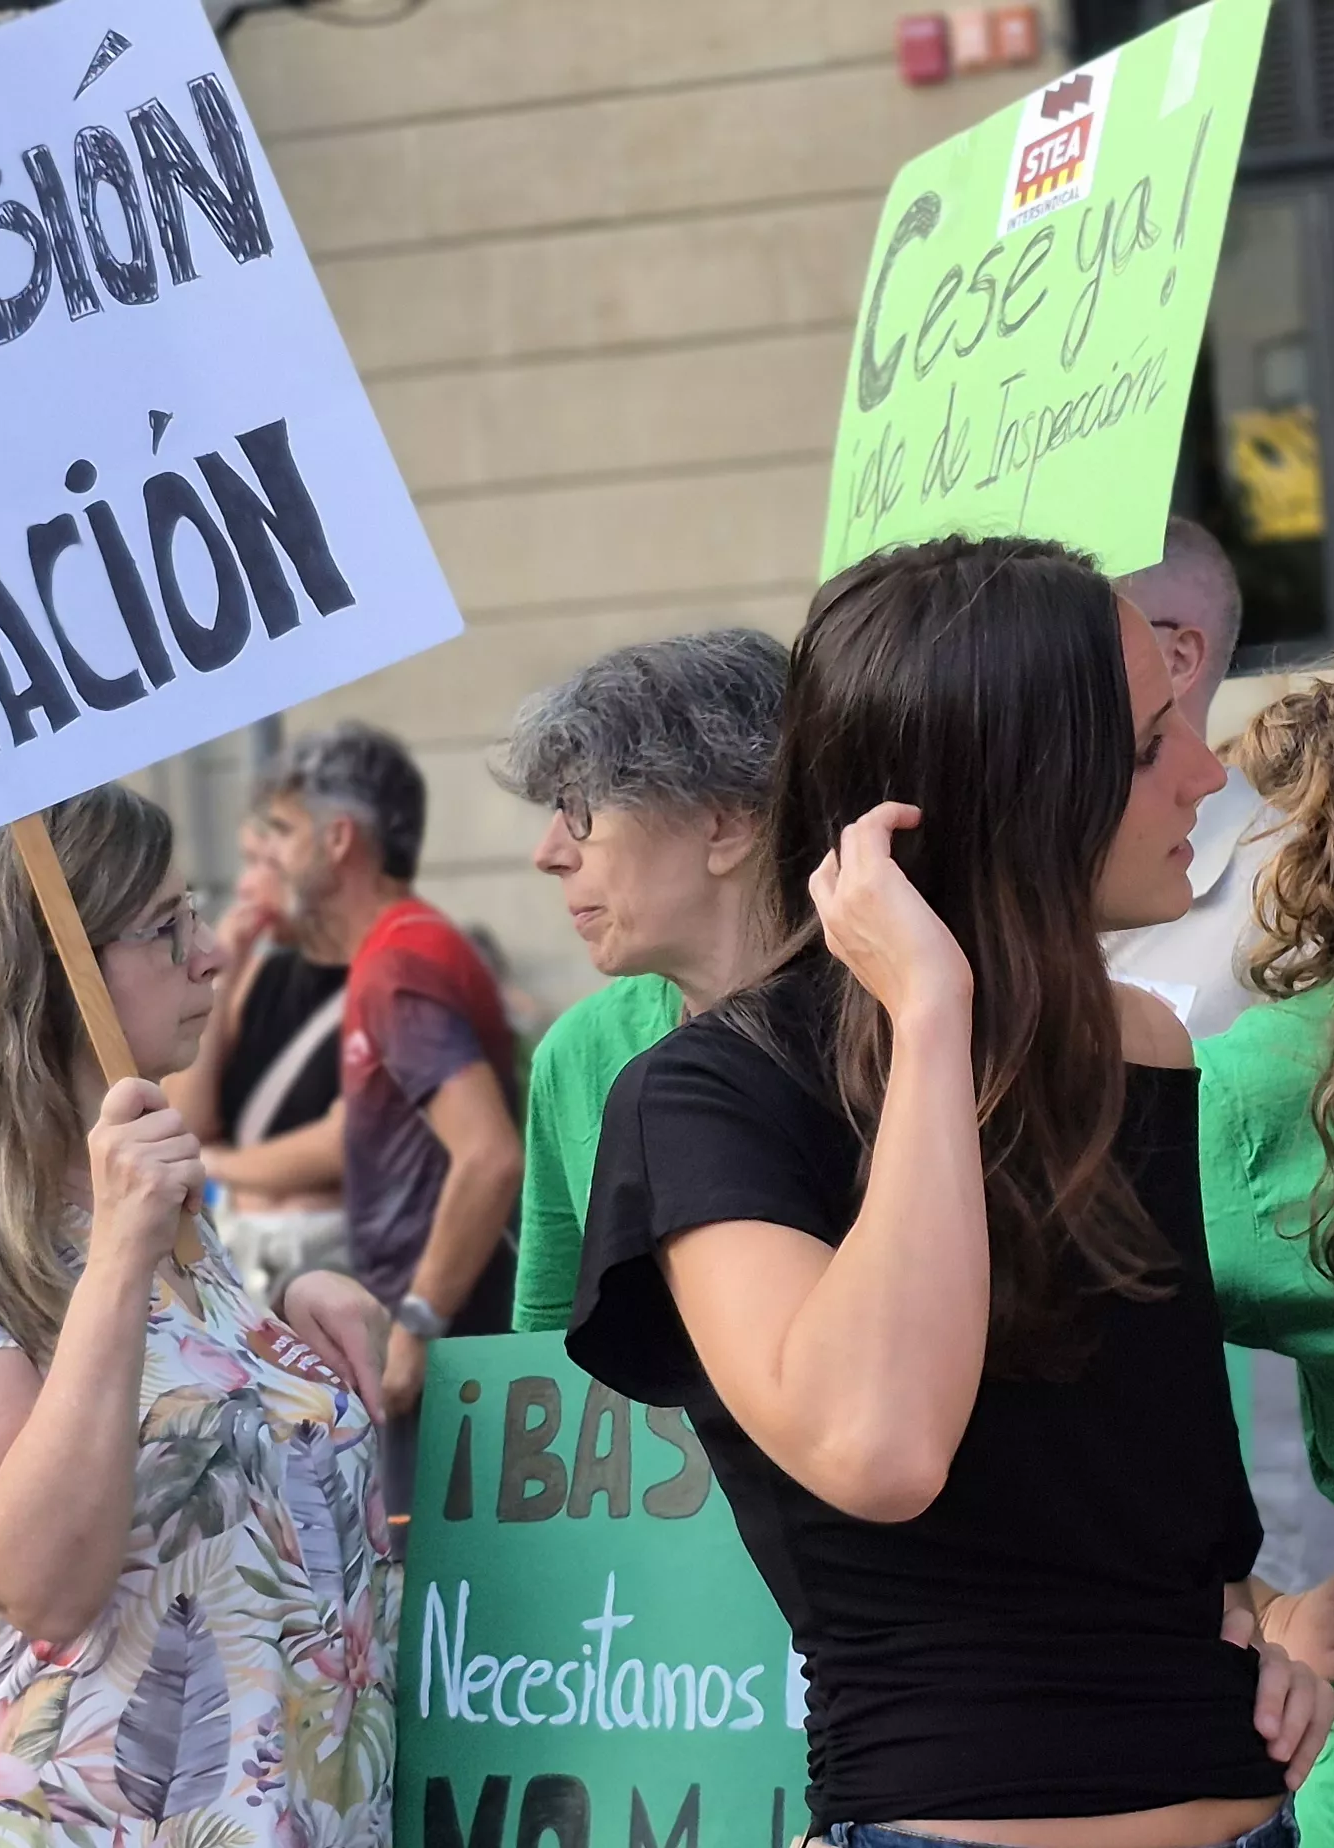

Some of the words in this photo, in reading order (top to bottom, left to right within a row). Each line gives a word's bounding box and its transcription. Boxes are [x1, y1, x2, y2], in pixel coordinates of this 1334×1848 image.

[1007, 186, 1080, 233] INTERSINDICAL
[1022, 125, 1081, 183] STEA
[857, 190, 1055, 414] Cese
[920, 381, 971, 505] de
[974, 336, 1168, 534] Inspección
[442, 1374, 712, 1523] ¡BAS
[419, 1571, 766, 1730] Necesitamos
